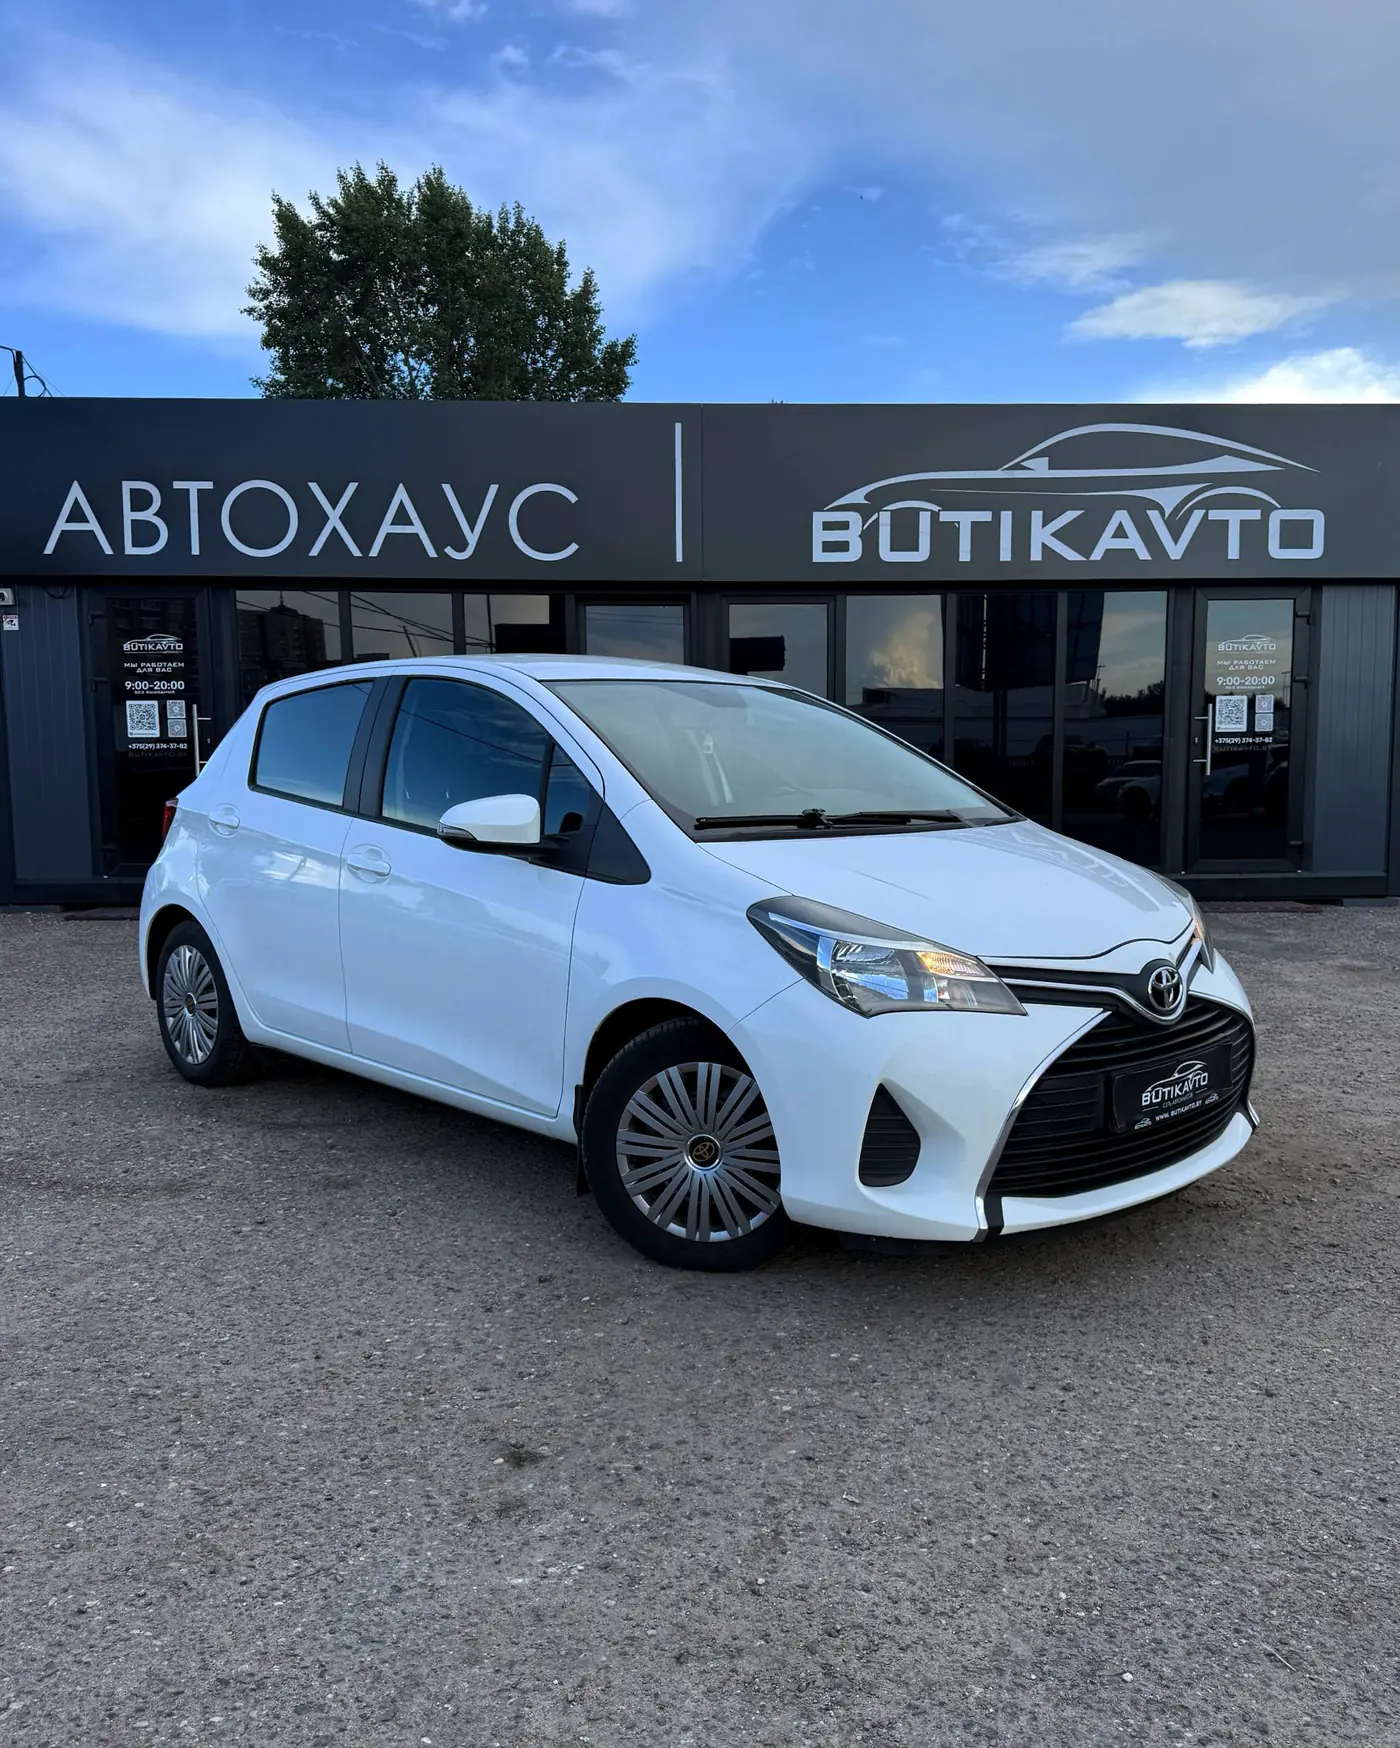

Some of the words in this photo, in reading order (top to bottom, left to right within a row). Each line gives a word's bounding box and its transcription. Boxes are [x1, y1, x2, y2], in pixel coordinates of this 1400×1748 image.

[43, 479, 580, 562] АВТОХАУС
[812, 508, 1325, 563] BUTIKAVTO
[123, 642, 184, 651] BUTIKAVTO
[1217, 643, 1277, 652] BUTIKAVTO
[124, 680, 185, 690] 9:00-20:00
[1216, 675, 1275, 686] 9:00-20:00
[128, 742, 155, 750] +375(29)
[1141, 1072, 1208, 1106] BUTIKAVTO
